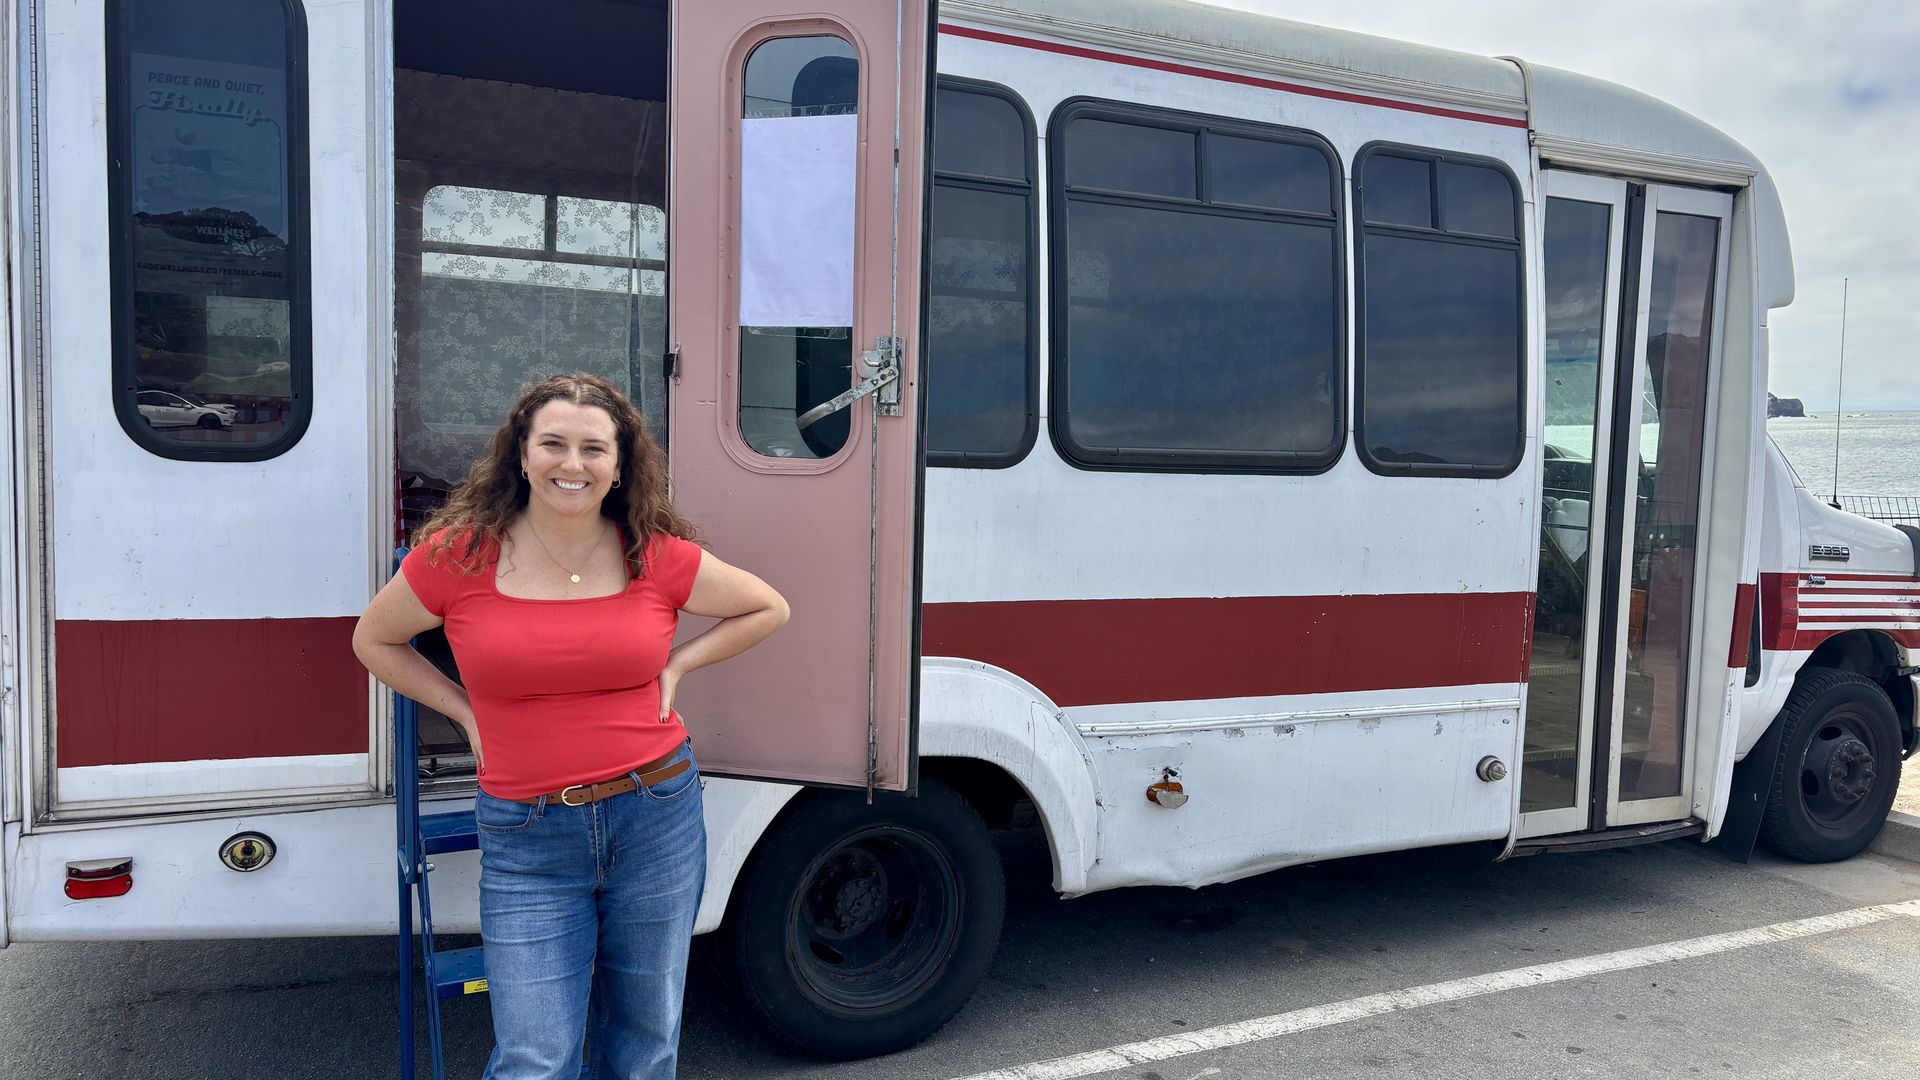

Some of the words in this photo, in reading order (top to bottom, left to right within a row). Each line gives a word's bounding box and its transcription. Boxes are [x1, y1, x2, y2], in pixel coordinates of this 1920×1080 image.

[147, 72, 191, 86] PEACE
[193, 77, 221, 89] AND
[195, 225, 251, 238] WELLNESS
